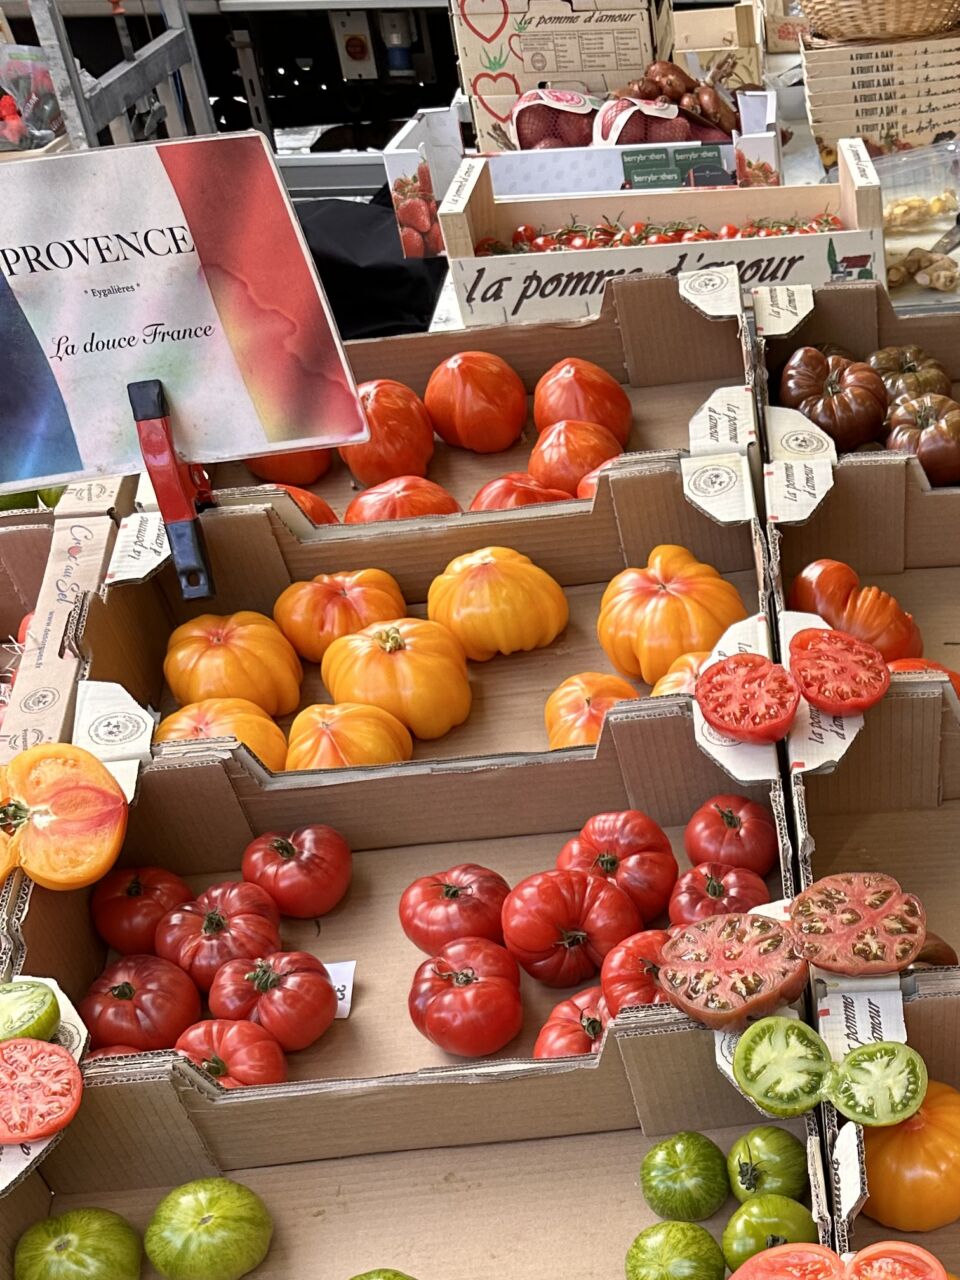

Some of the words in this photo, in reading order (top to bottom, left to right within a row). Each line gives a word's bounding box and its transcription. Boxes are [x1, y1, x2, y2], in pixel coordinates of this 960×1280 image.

[519, 14, 533, 25] la
[536, 15, 581, 28] pomme
[583, 12, 637, 24] d'amour
[880, 50, 894, 58] DAY
[881, 63, 894, 72] DAY
[882, 77, 895, 87] DAY
[884, 91, 897, 100] DAY
[885, 105, 898, 116] DAY
[886, 121, 898, 130] DAY
[0, 225, 196, 277] PROVENCE
[91, 285, 136, 298] Eygalières
[466, 268, 505, 304] la
[511, 266, 644, 317] pomm
[768, 307, 781, 319] la
[49, 336, 78, 361] La
[83, 332, 140, 353] douce
[142, 322, 216, 345] France
[727, 403, 741, 414] la
[708, 406, 723, 444] d'amour
[726, 413, 740, 445] pomme
[784, 462, 803, 492] pomme
[803, 463, 818, 499] d'amour
[783, 486, 798, 503] la
[134, 516, 150, 550] pomme
[127, 543, 143, 561] la
[55, 578, 80, 605] Sel
[808, 704, 829, 731] pom
[830, 715, 847, 741] d'am
[808, 730, 825, 745] la
[841, 994, 865, 1047] pomme
[866, 998, 884, 1043] 'amour
